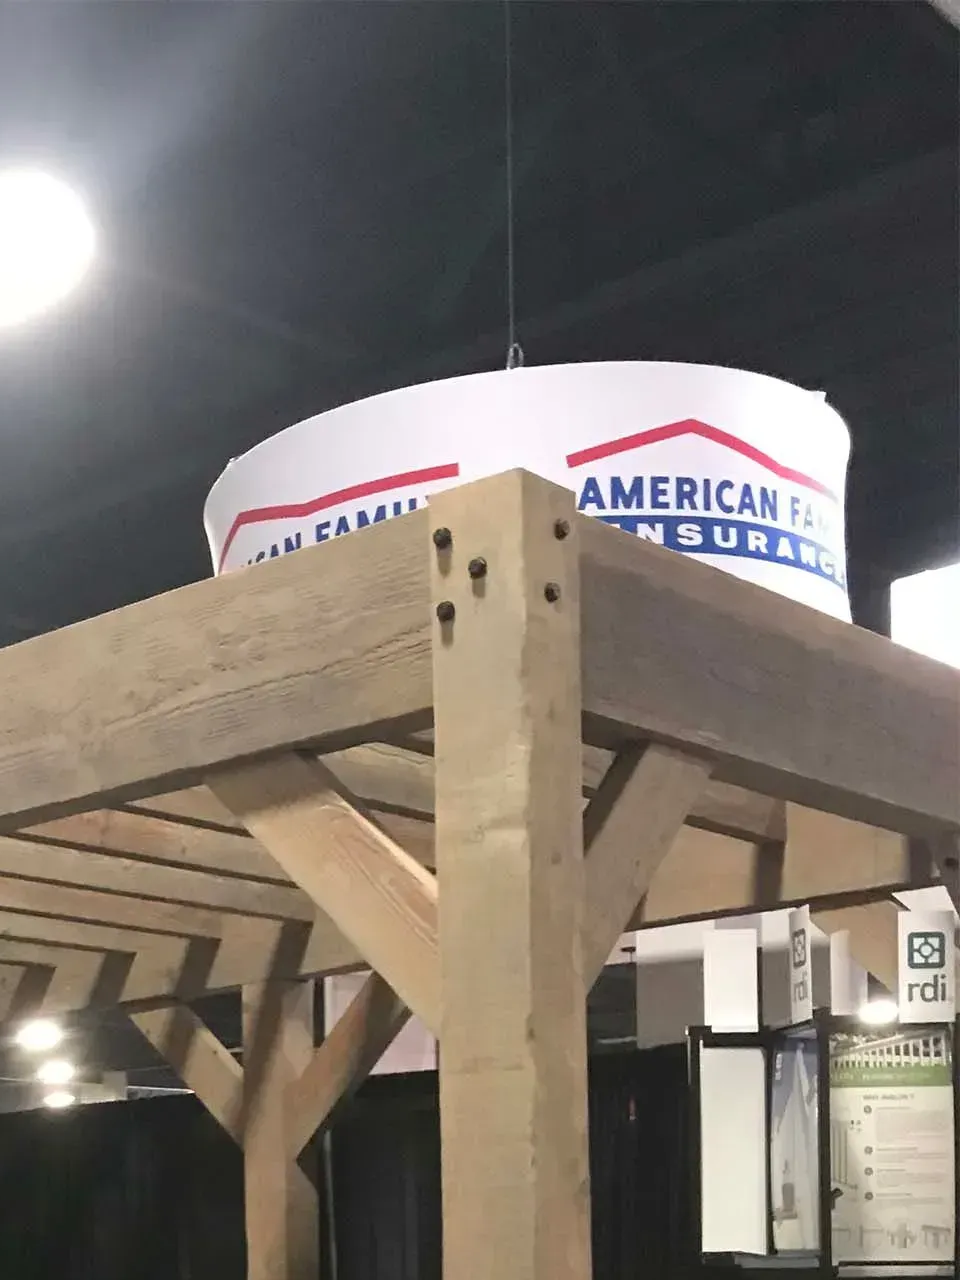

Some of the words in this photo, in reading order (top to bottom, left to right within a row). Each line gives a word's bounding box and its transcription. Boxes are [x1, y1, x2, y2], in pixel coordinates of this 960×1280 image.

[578, 475, 778, 522] AMERICAN
[610, 522, 846, 588] NSURANC
[907, 974, 947, 1003] rdi
